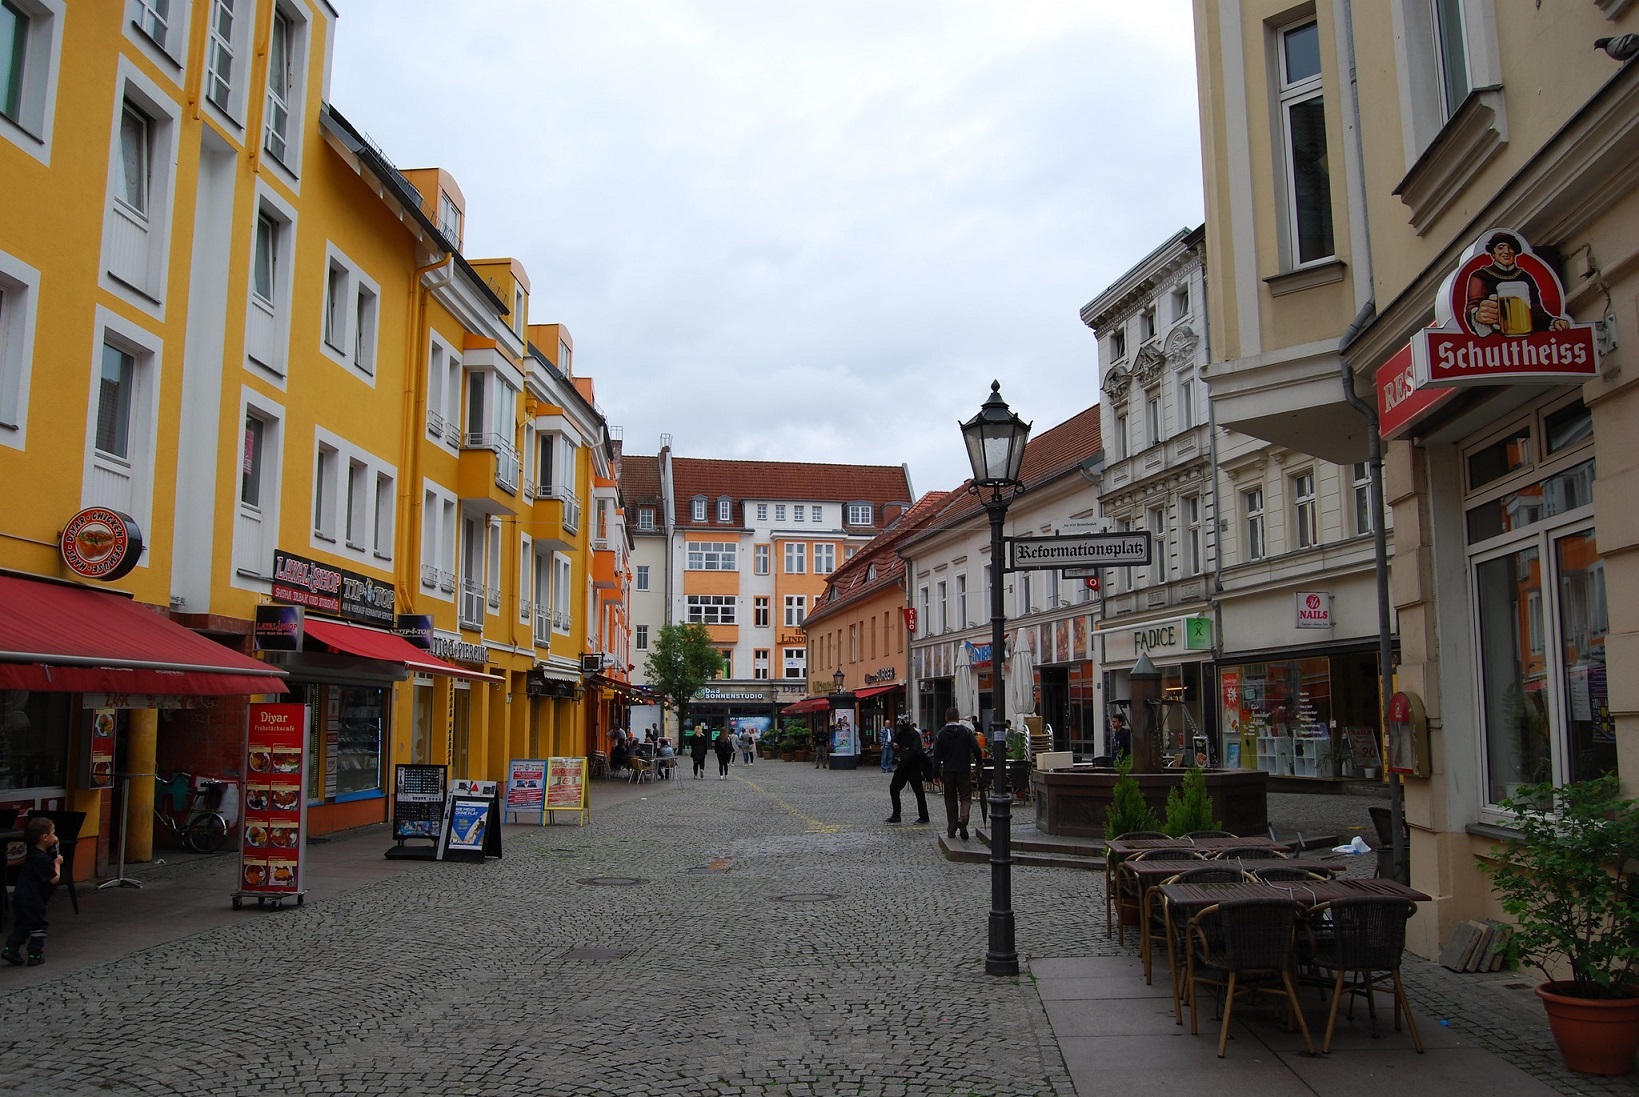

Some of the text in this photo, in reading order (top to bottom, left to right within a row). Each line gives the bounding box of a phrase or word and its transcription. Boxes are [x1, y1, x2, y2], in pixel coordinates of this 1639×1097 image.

[1438, 337, 1587, 369] Schultheiss
[66, 516, 86, 543] DIYAR
[92, 512, 124, 538] CHICKEN
[67, 550, 87, 571] HAUS
[1017, 540, 1143, 559] Reformationsplatz
[293, 591, 309, 604] TABAK
[343, 577, 395, 610] TIP TOP
[1300, 610, 1328, 619] NAILS
[1134, 626, 1176, 656] FADICE
[261, 711, 288, 724] Diyar
